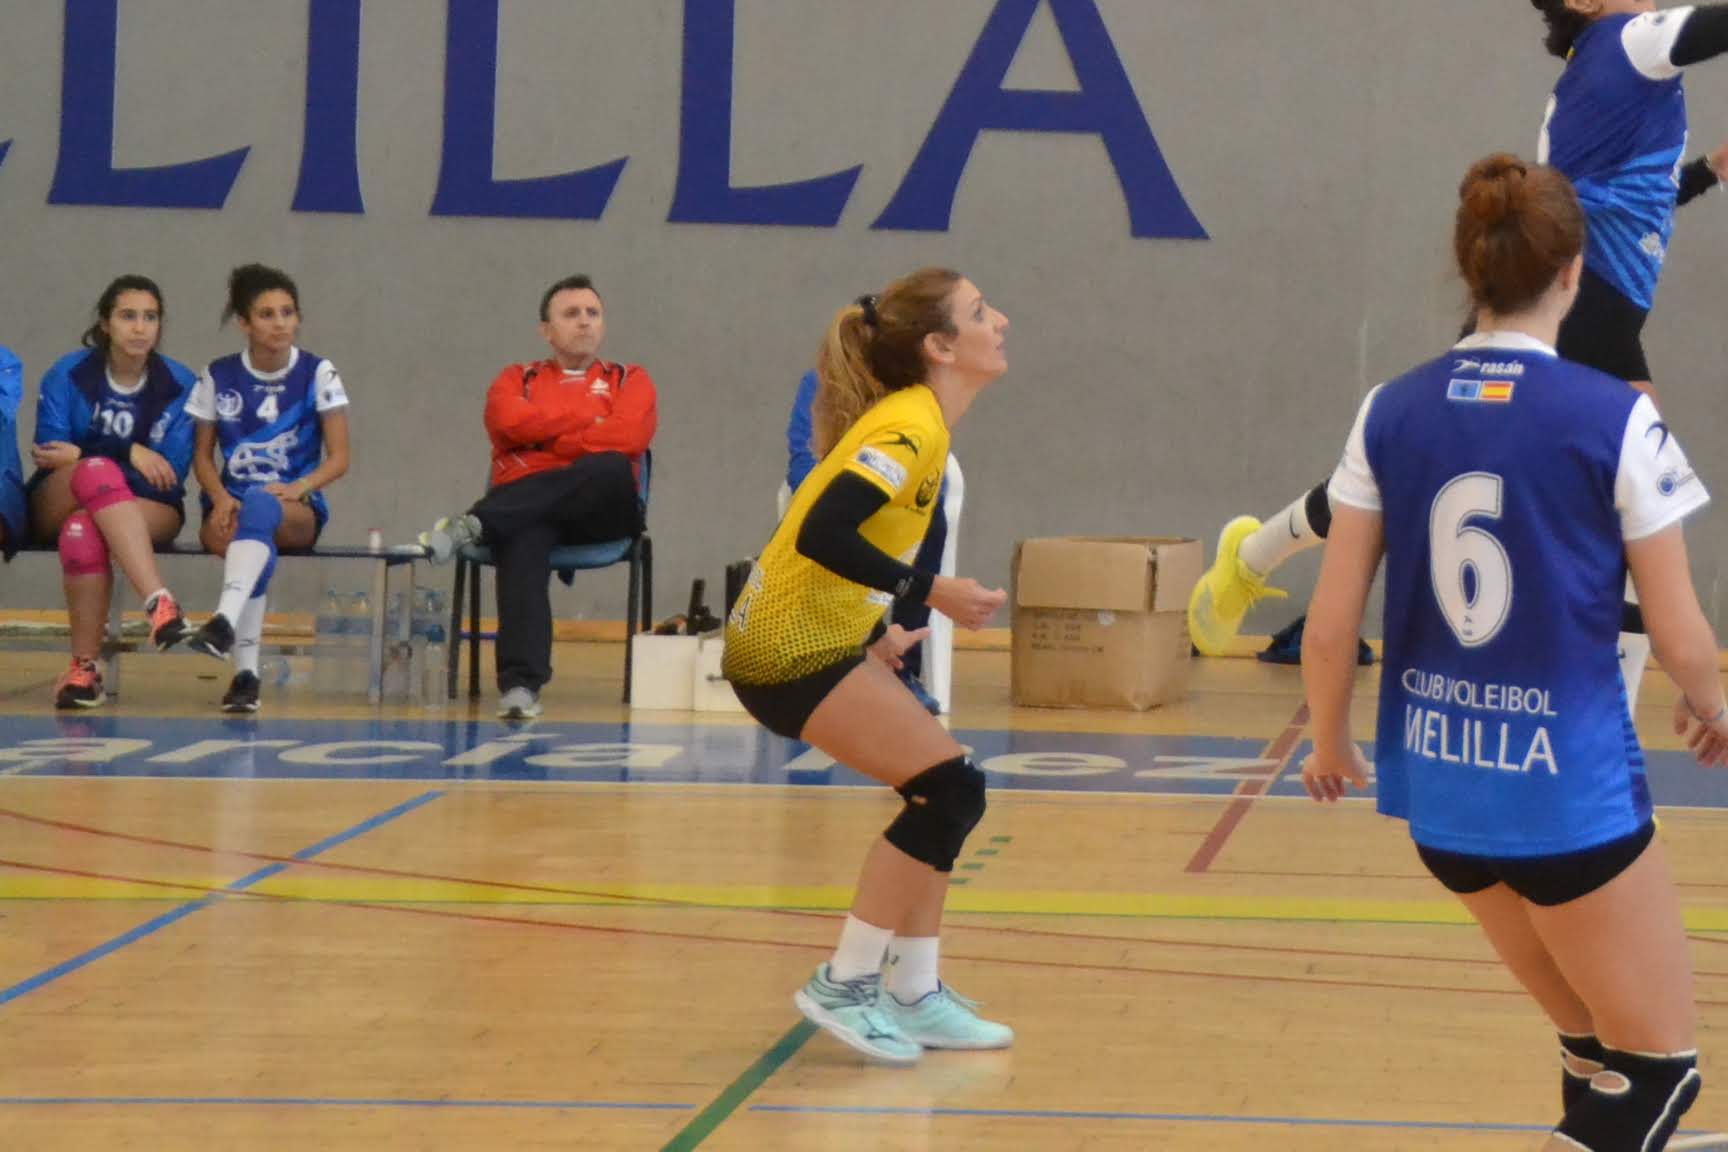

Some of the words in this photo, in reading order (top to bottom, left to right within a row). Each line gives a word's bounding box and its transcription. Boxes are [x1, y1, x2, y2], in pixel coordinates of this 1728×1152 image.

[101, 409, 134, 439] 10
[256, 393, 280, 423] 4
[1430, 470, 1513, 648] 6
[1401, 667, 1446, 700] CLUB
[1403, 703, 1560, 775] MELILLA
